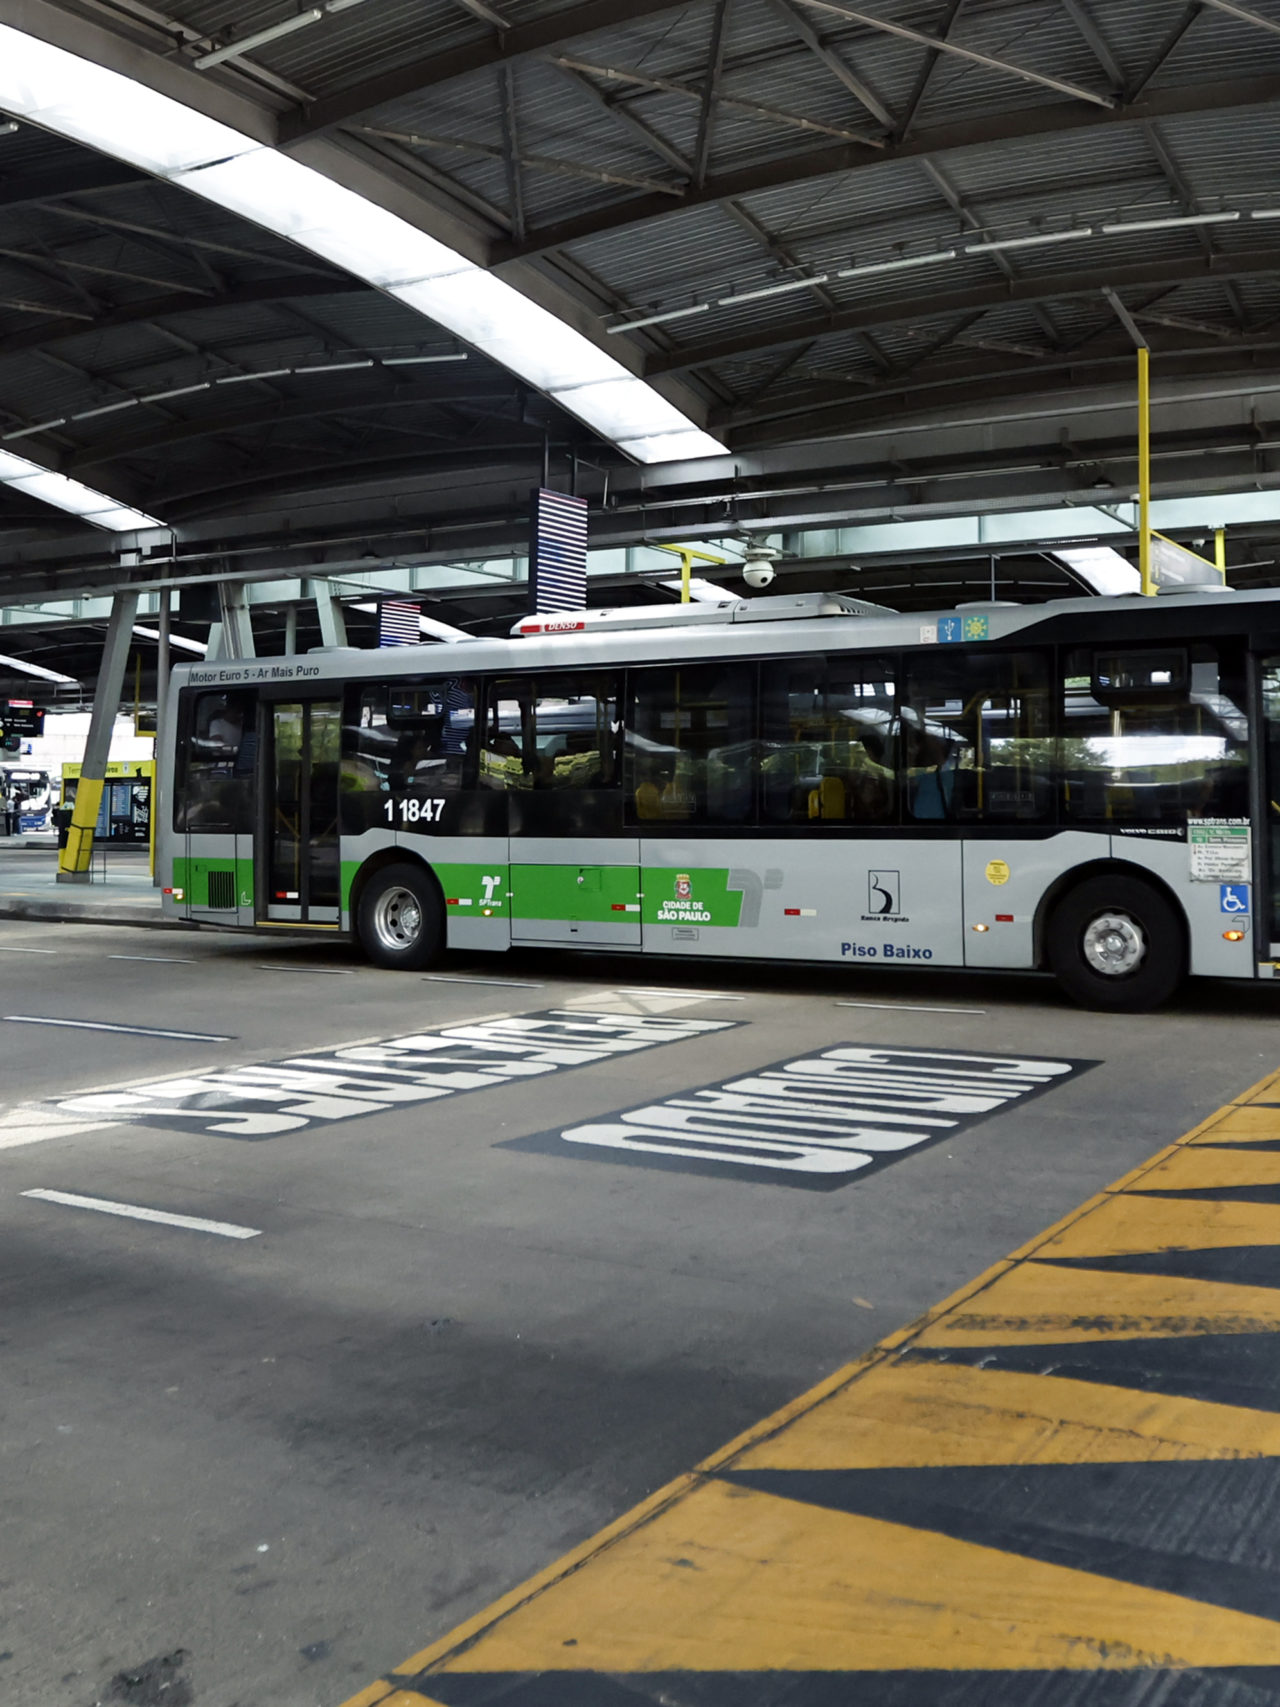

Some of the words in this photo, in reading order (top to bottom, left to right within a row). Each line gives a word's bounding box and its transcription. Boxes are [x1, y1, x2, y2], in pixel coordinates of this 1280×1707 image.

[548, 621, 577, 631] DENSO
[190, 672, 217, 683] Motor
[219, 669, 241, 681] Euro
[243, 668, 250, 680] 5
[257, 667, 268, 679] Ar
[271, 667, 294, 678] Mais
[296, 665, 320, 676] Puro
[384, 798, 394, 822] 1
[399, 798, 446, 822] 1847
[662, 900, 691, 910] CIDADE
[692, 901, 704, 911] DE
[657, 908, 678, 920] SÃO
[678, 911, 711, 922] PAULO
[841, 942, 877, 957] Piso
[883, 943, 933, 960] Baixo
[560, 1047, 1074, 1174] CUIDADO
